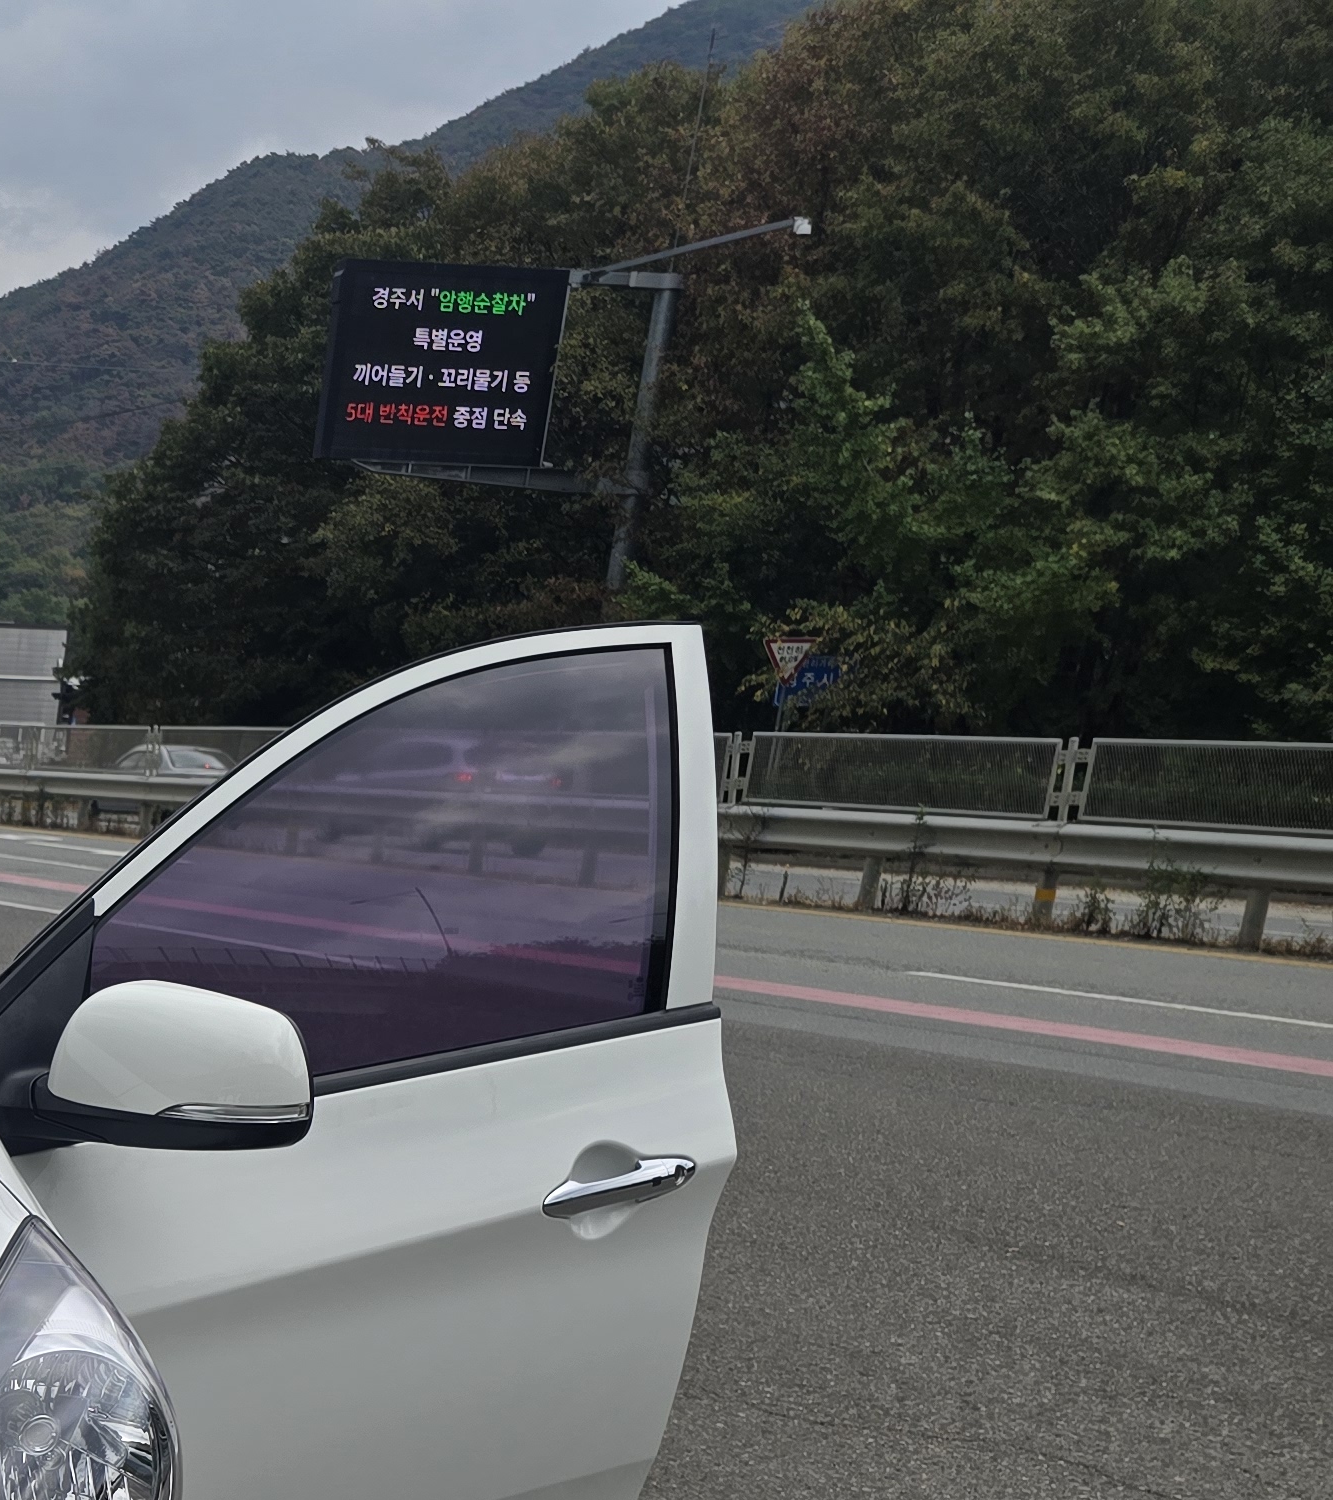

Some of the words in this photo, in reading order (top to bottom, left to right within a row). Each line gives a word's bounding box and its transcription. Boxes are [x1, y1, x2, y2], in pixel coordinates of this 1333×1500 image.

[372, 287, 425, 311] 경주서
[431, 288, 536, 316] "암행순찰차"
[413, 327, 483, 352] 특별운영
[353, 363, 424, 388] 끼어들기
[437, 367, 508, 392] 꼬리물기
[513, 371, 531, 393] 등
[345, 402, 374, 423] 5대
[379, 403, 448, 427] 반칙운전
[453, 406, 487, 430] 중점
[493, 408, 527, 431] 단속
